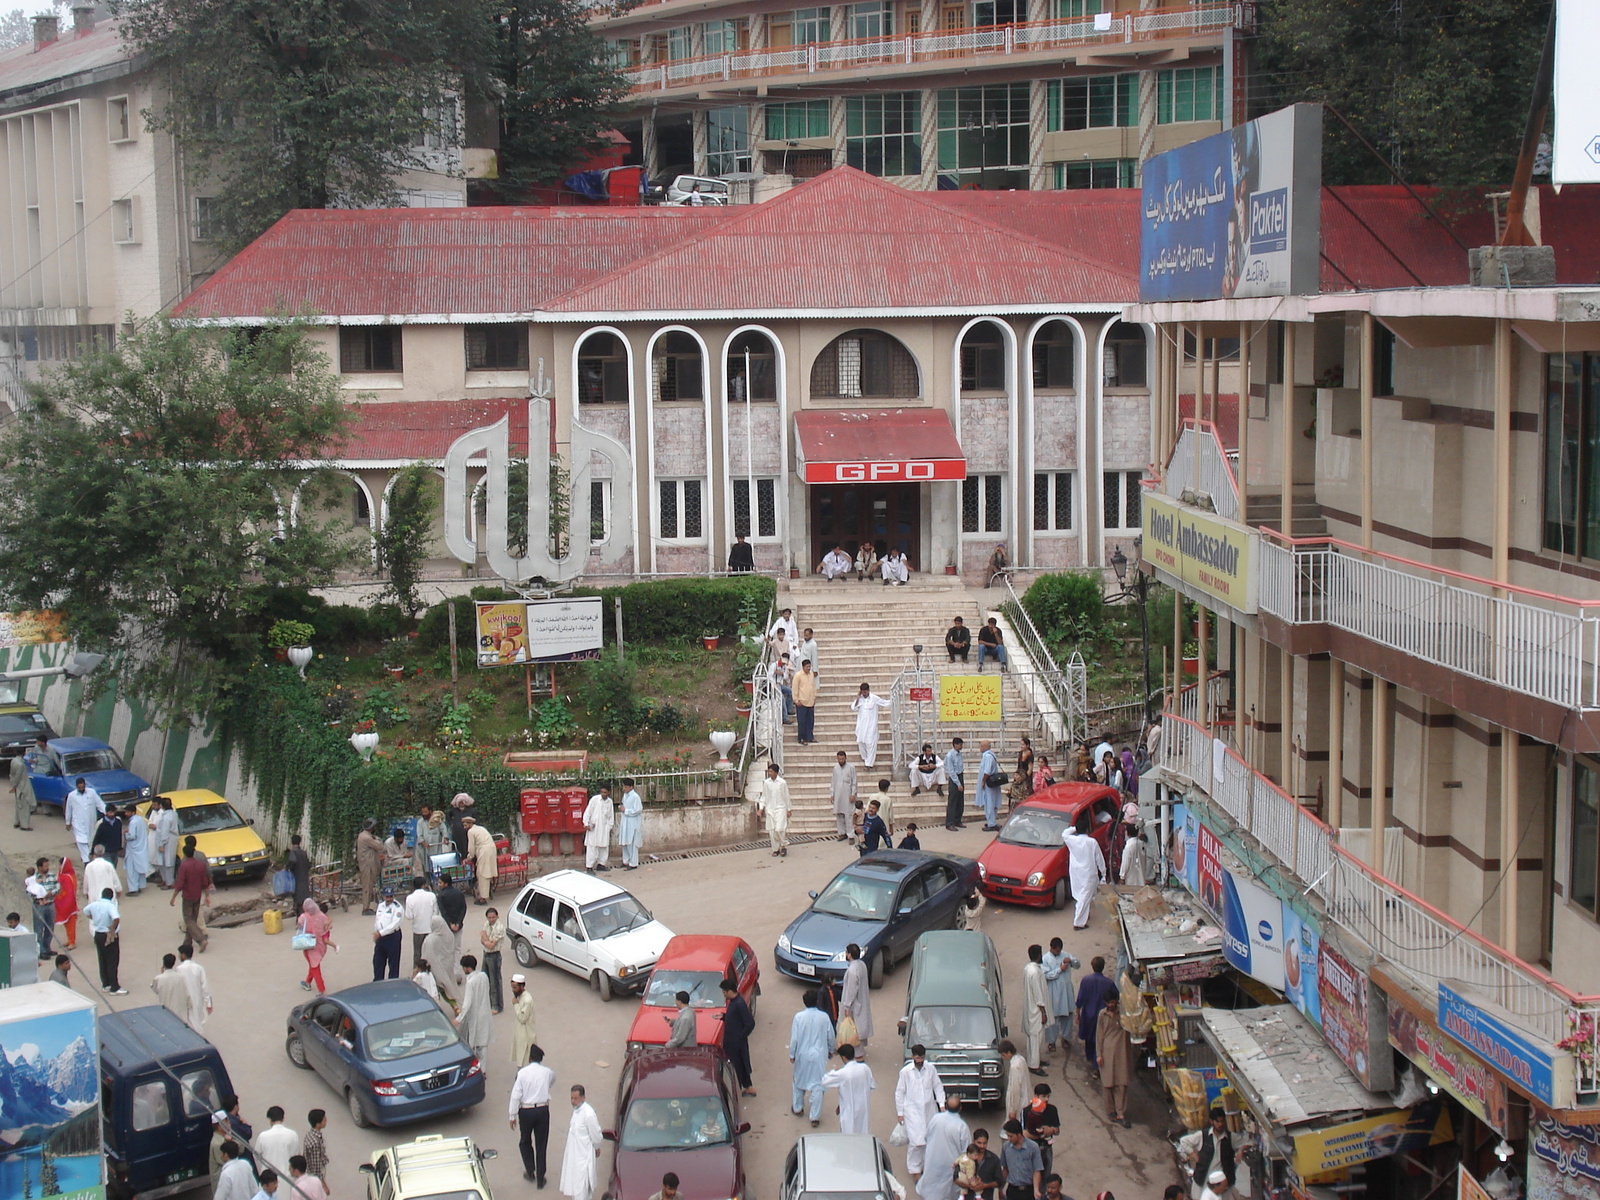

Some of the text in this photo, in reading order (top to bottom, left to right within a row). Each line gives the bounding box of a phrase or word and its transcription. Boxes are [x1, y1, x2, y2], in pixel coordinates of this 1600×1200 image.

[1251, 194, 1286, 237] Paktel
[1191, 247, 1206, 268] PTCL
[835, 462, 934, 481] GPO
[1150, 507, 1239, 578] Hotel Ambassador
[1199, 569, 1230, 595] FAMILY ROOMS
[1202, 853, 1223, 886] COLDS
[1443, 989, 1478, 1024] Hotel
[1444, 1009, 1533, 1088] AMBASSADOR
[1320, 1159, 1344, 1169] CALL
